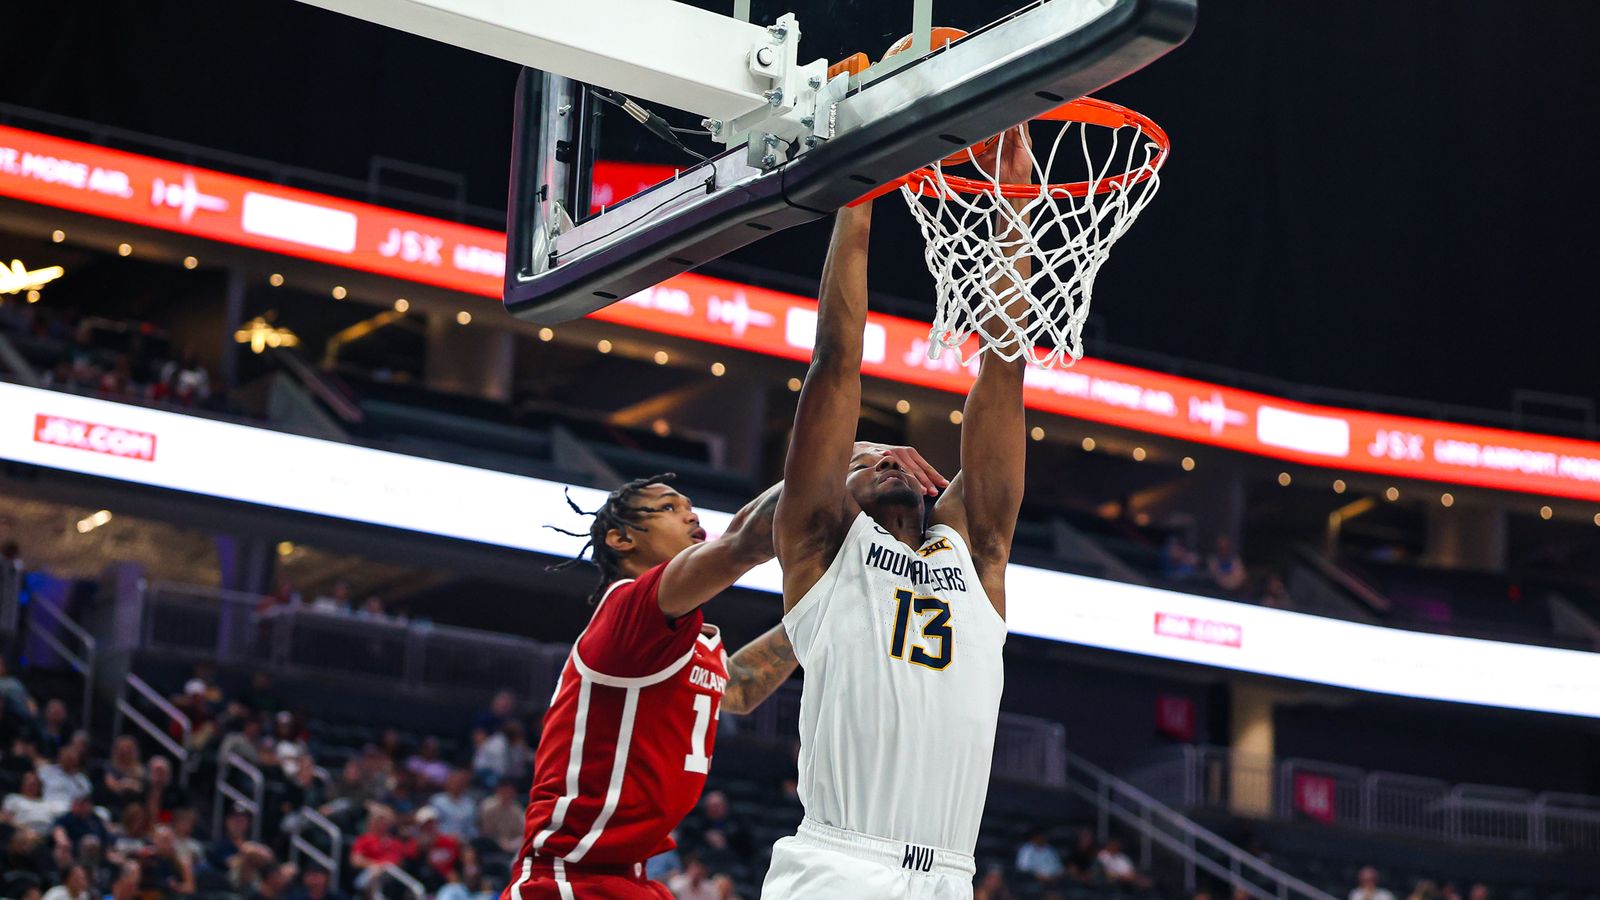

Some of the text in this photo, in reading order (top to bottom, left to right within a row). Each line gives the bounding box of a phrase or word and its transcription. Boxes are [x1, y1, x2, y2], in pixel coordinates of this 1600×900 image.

[377, 227, 444, 267] JSX
[39, 417, 153, 459] JSX.COM
[1367, 429, 1425, 462] JSX
[888, 586, 953, 671] 13
[689, 664, 728, 696] OKLAH
[683, 693, 721, 775] 1
[901, 844, 934, 872] WVU
